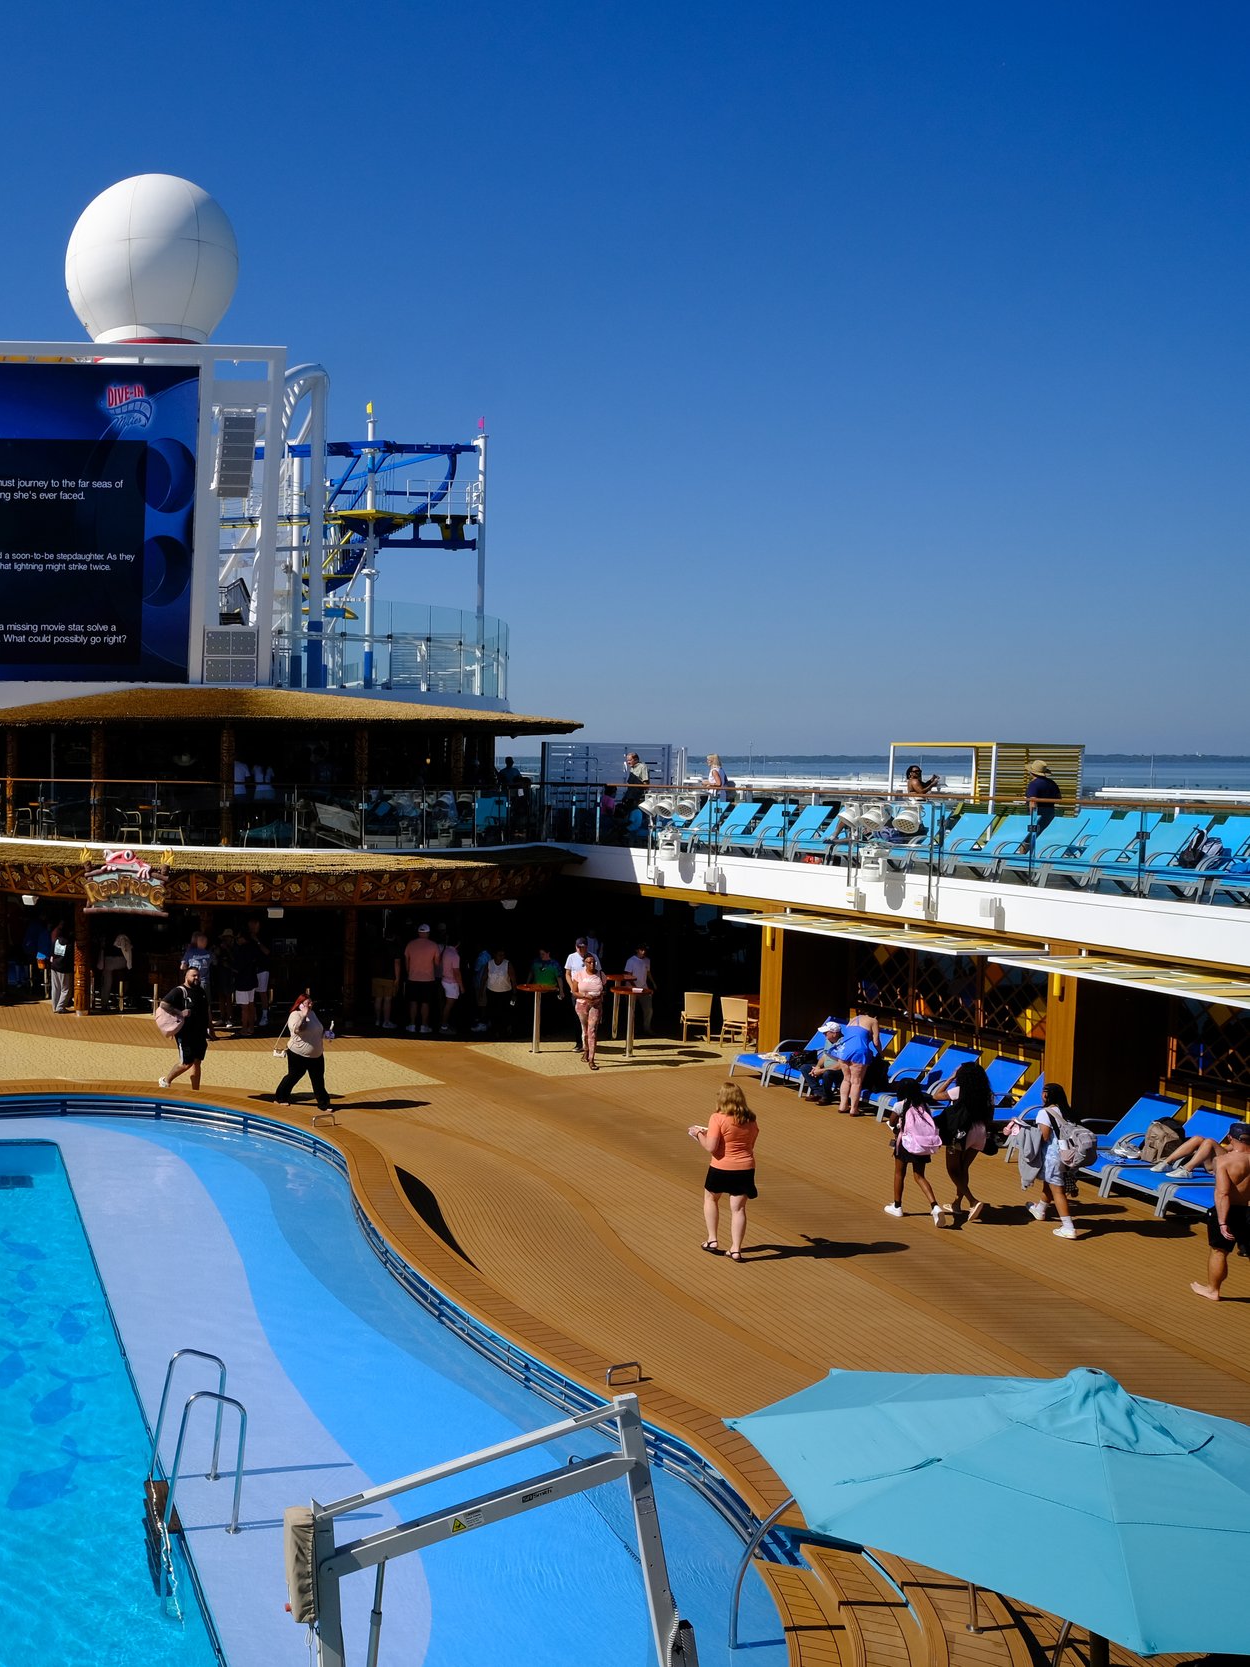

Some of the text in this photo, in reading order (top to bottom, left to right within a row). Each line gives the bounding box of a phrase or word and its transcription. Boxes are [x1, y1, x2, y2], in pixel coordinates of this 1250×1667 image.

[107, 385, 145, 407] DIVE-IN
[17, 478, 48, 489] journey
[51, 479, 59, 487] to
[61, 479, 75, 487] the
[78, 478, 89, 487] far
[114, 479, 123, 488] of
[13, 490, 36, 499] she's
[59, 490, 85, 499] faced.
[106, 552, 117, 560] As
[119, 552, 134, 562] they
[13, 562, 43, 571] lightning
[45, 562, 65, 571] might
[68, 562, 87, 570] strike
[6, 622, 38, 632] missing
[40, 622, 65, 631] movie
[86, 623, 108, 631] solve
[3, 634, 25, 642] What
[28, 634, 50, 642] could
[53, 634, 87, 644] possibly
[90, 636, 101, 645] go
[103, 634, 126, 645] right?
